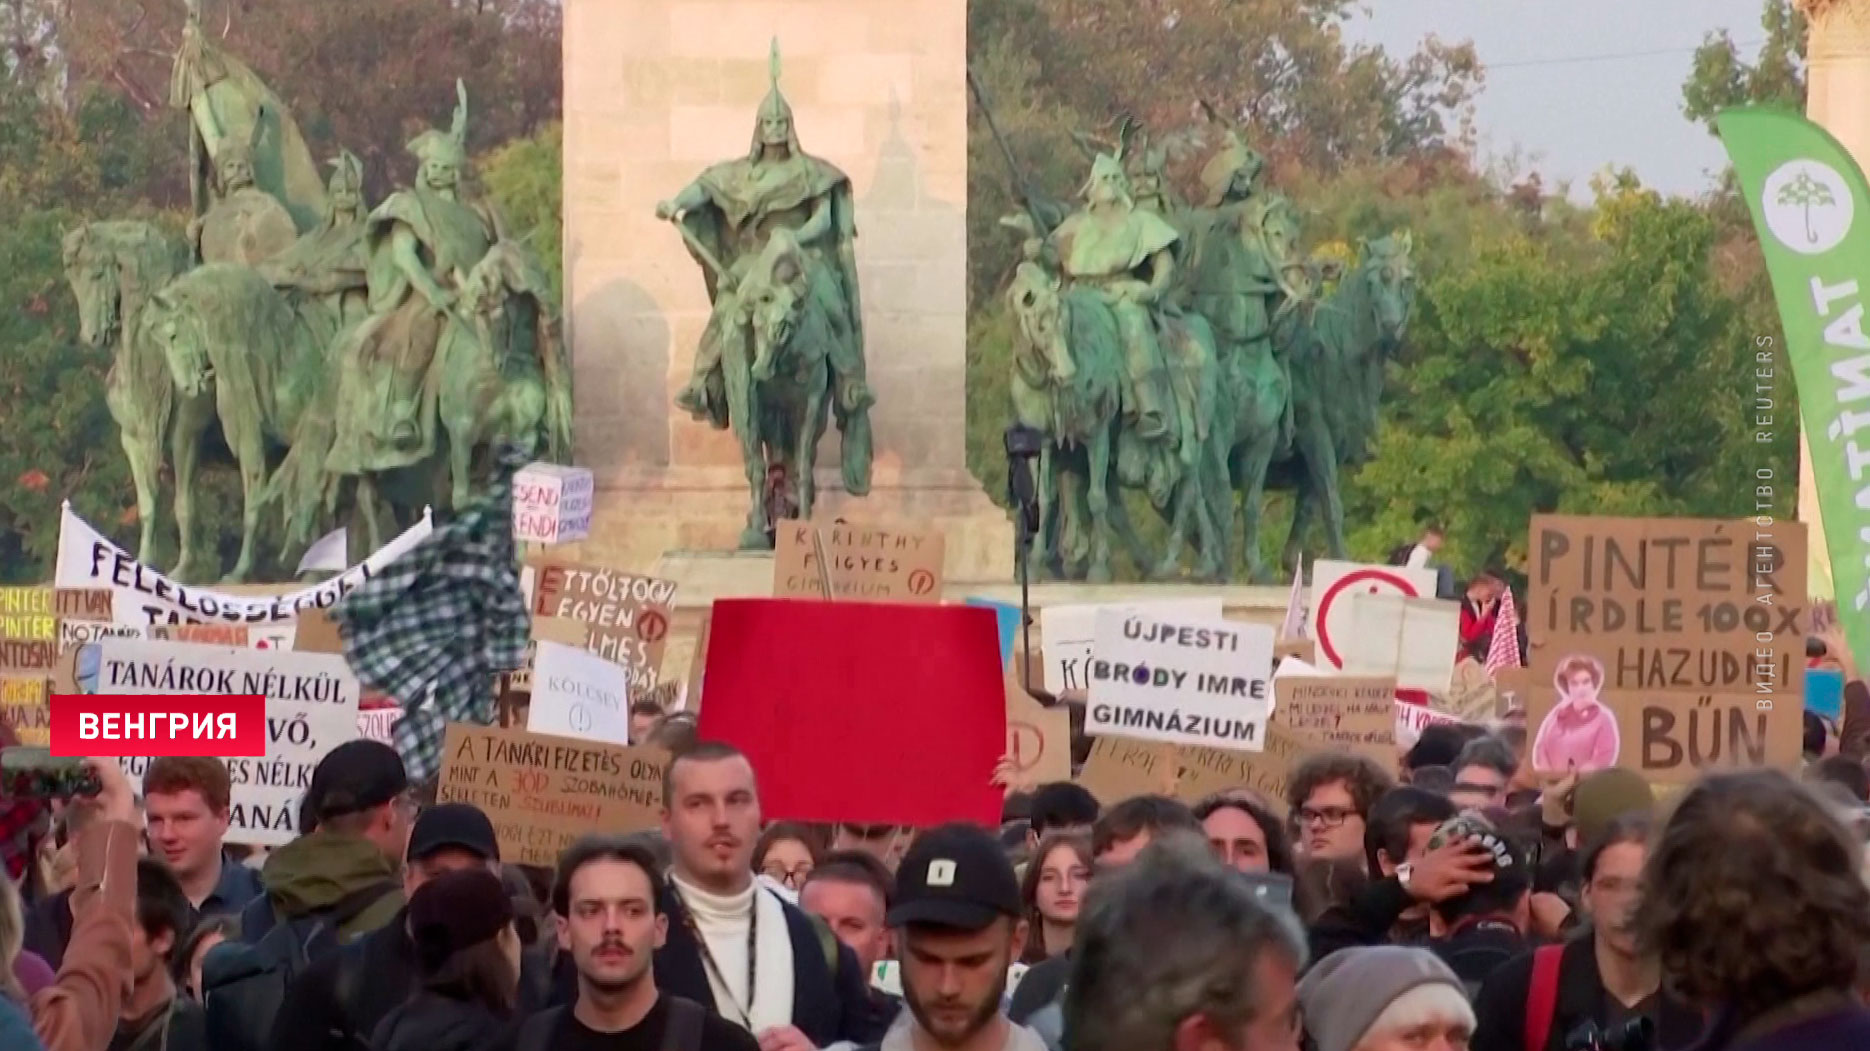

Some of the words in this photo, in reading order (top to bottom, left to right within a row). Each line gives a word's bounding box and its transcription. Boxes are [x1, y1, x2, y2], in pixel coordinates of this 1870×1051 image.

[795, 527, 925, 549] KRINTHY
[804, 553, 899, 573] FIGYES
[1540, 525, 1785, 596] PINTÉR
[1124, 615, 1238, 651] ÚJPESTI
[106, 657, 237, 694] TANÁROK
[1094, 661, 1187, 690] BRÓDY
[1197, 673, 1265, 699] IMRE
[1615, 646, 1790, 689] HAZUDNI
[266, 711, 316, 750] VŐ,
[1092, 703, 1255, 741] GIMNÁZIUM
[1641, 697, 1767, 770] BŰN
[457, 736, 474, 761] A
[482, 736, 549, 769] TANÁRI
[255, 754, 320, 790] NÉLK
[450, 765, 479, 782] MINT
[486, 768, 498, 787] A
[229, 799, 293, 831] ANÁ
